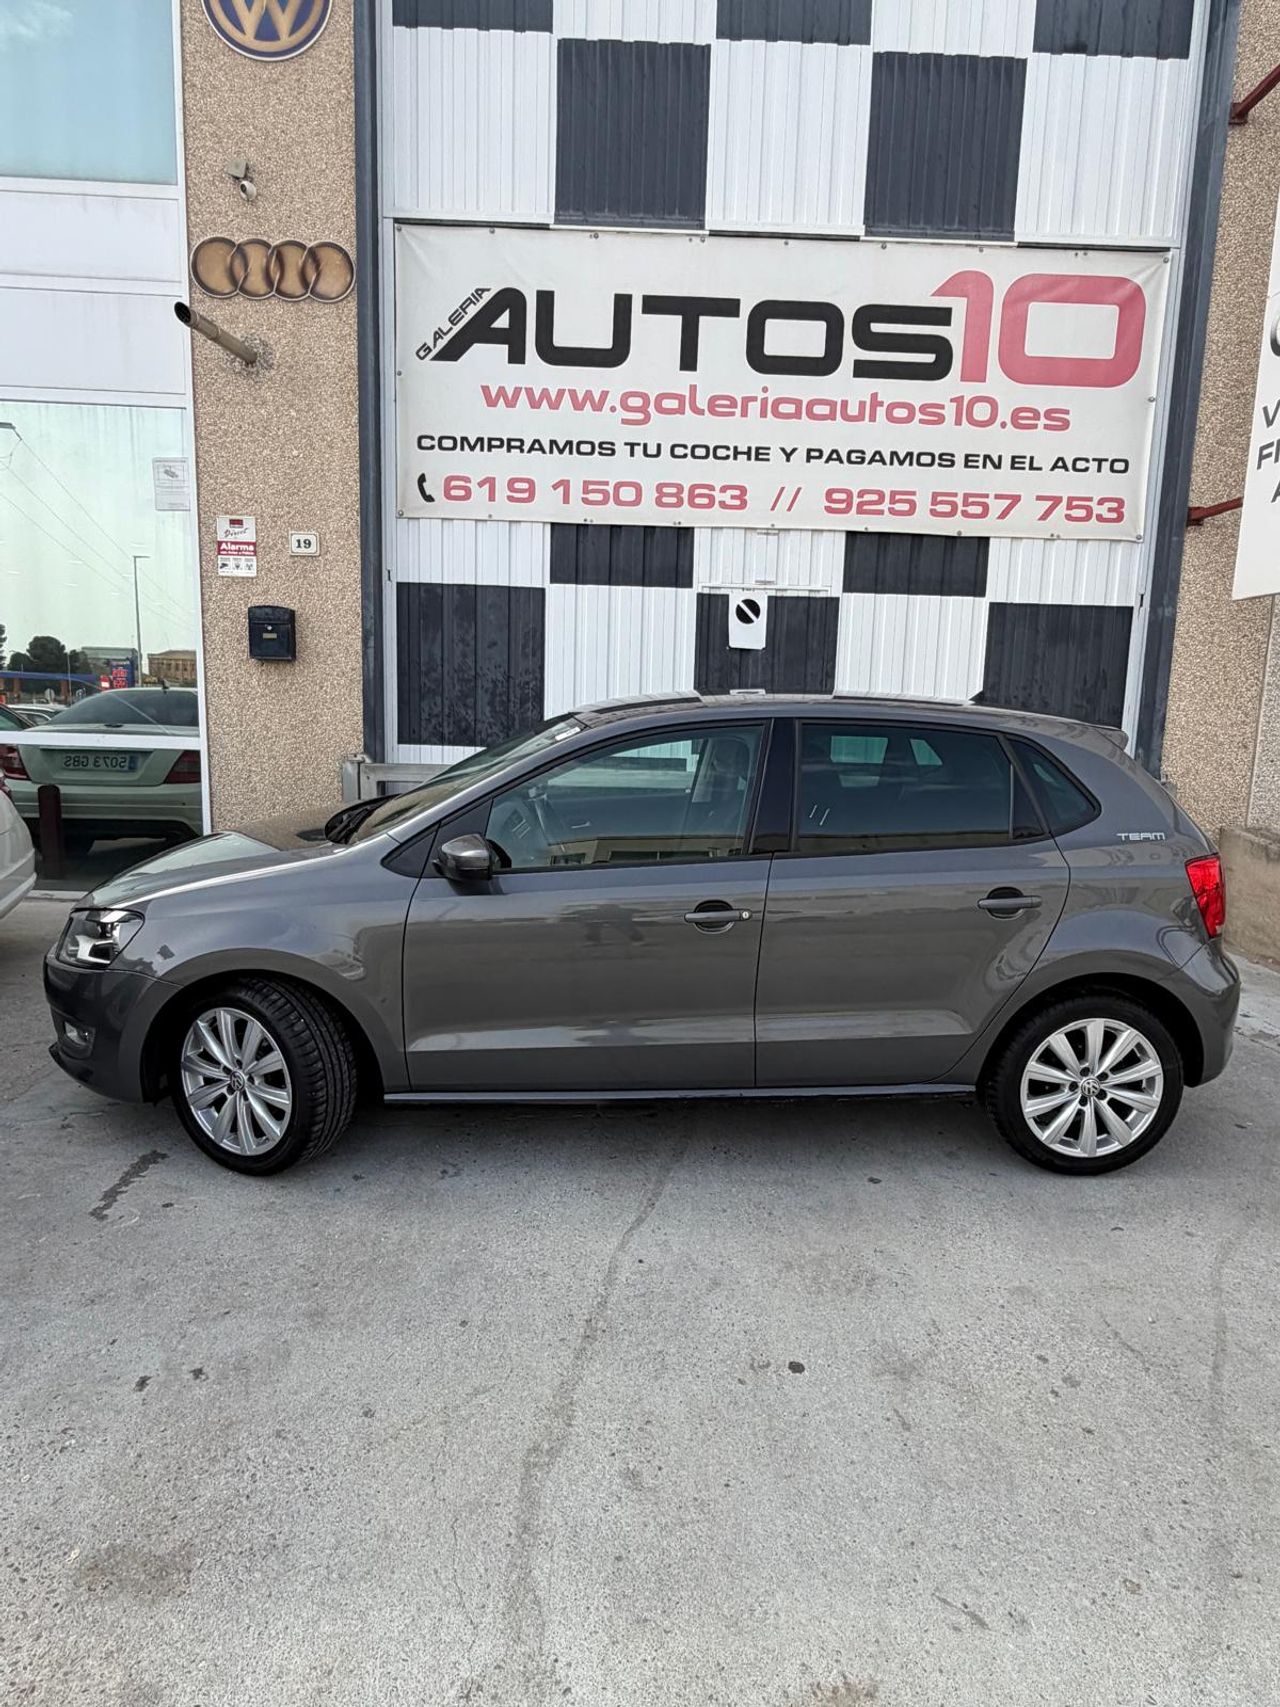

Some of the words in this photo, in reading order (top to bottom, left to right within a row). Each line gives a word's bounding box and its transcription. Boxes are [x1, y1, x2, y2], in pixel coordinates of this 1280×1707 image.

[415, 287, 492, 361] GALERIA
[429, 269, 1147, 388] AUTOS10
[480, 384, 1071, 431] www.galeriaautos10.es
[417, 435, 616, 457] COMPRAMOS
[624, 442, 662, 459] TU
[669, 443, 772, 462] COCHE
[779, 447, 798, 463] Y
[805, 448, 956, 468] PAGAMOS
[963, 453, 1003, 470] EN
[1010, 455, 1043, 471] EL
[1050, 456, 1130, 474] ACTO
[443, 475, 537, 504] 619
[551, 479, 643, 508] 150
[654, 482, 749, 511] 863
[824, 487, 918, 517] 925
[929, 491, 1022, 521] 557
[1035, 494, 1126, 524] 753
[219, 542, 255, 551] Alarma
[295, 538, 312, 549] 19
[1116, 832, 1166, 841] TEAM
